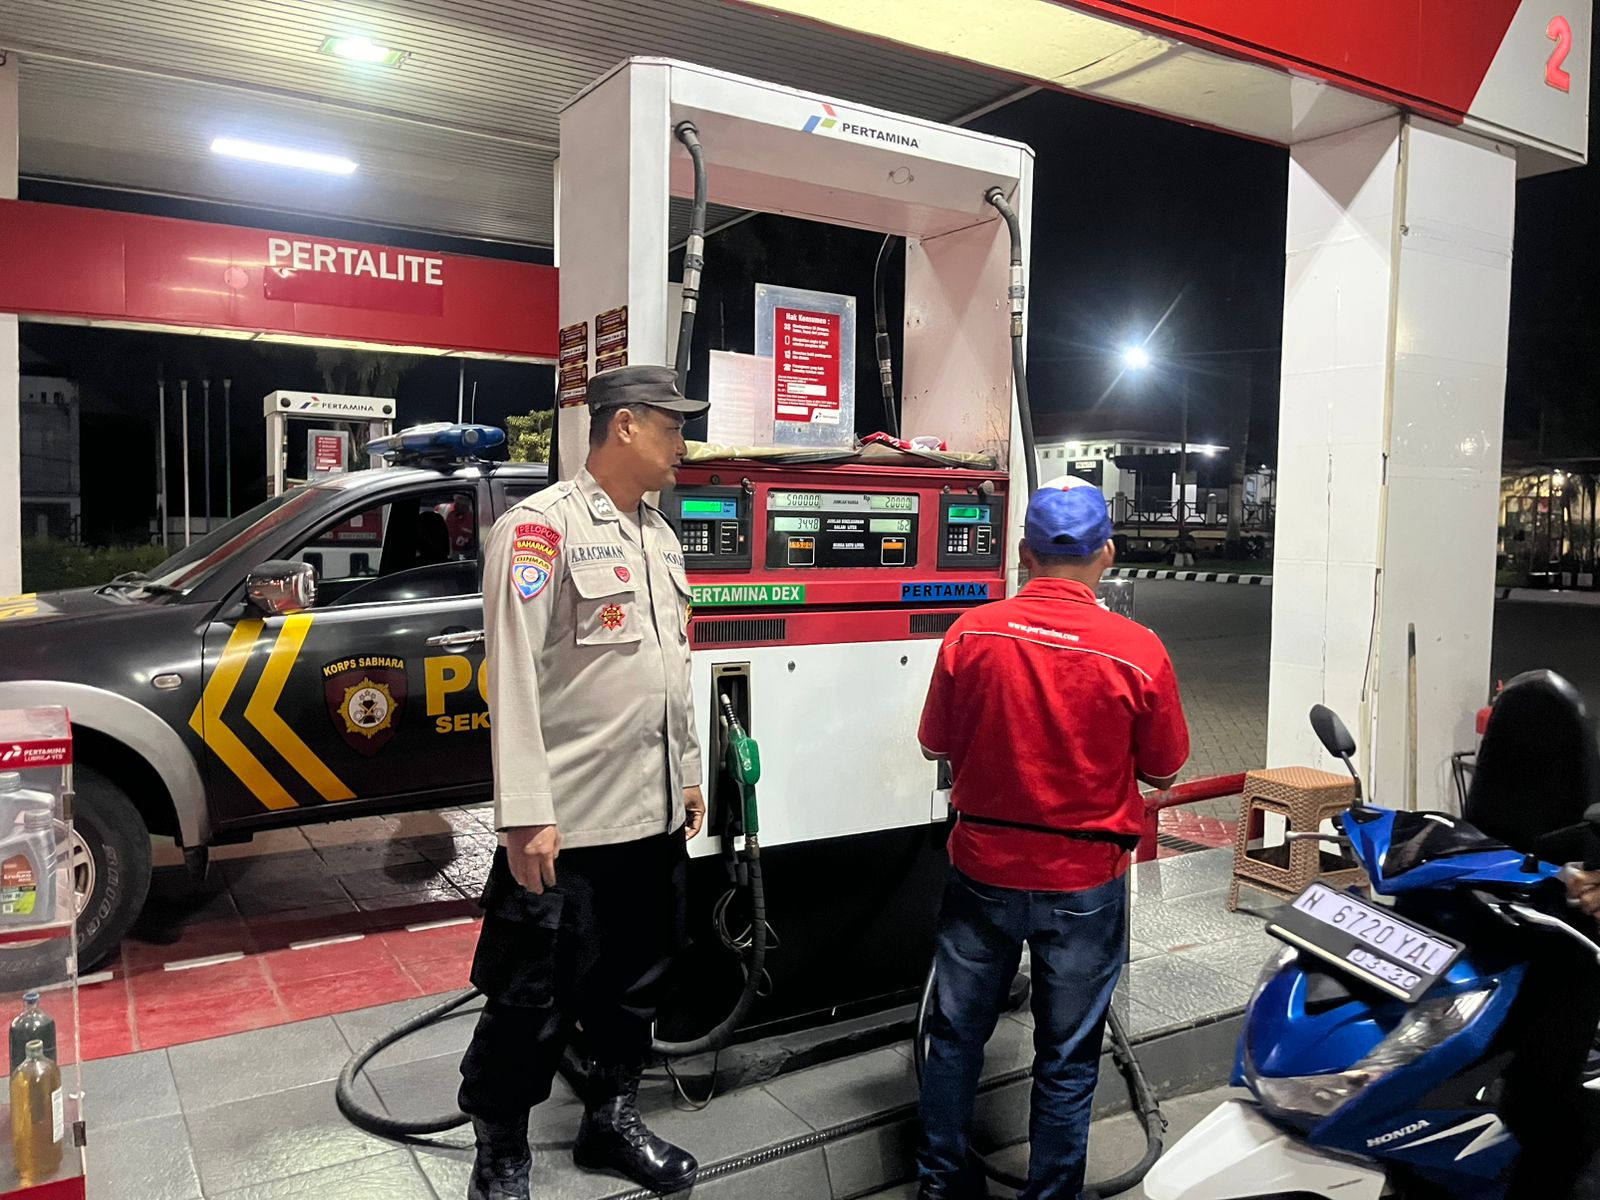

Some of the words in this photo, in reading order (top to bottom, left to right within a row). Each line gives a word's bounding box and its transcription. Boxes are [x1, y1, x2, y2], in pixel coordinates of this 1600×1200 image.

[1544, 15, 1573, 95] 2
[842, 122, 919, 148] PERTAMINA
[268, 237, 444, 286] PERTALITE
[322, 402, 374, 412] PERTAMINA
[692, 586, 768, 603] ERTAMINA
[772, 585, 800, 601] DEX
[902, 583, 987, 598] PERTAMAX
[323, 659, 356, 677] KORPS
[359, 657, 404, 669] SABHARA
[24, 748, 66, 756] PERTAMINA
[1301, 890, 1325, 911] N
[1333, 906, 1394, 944] 6720
[1394, 933, 1440, 972] YAL
[1366, 1119, 1431, 1147] HONDA
